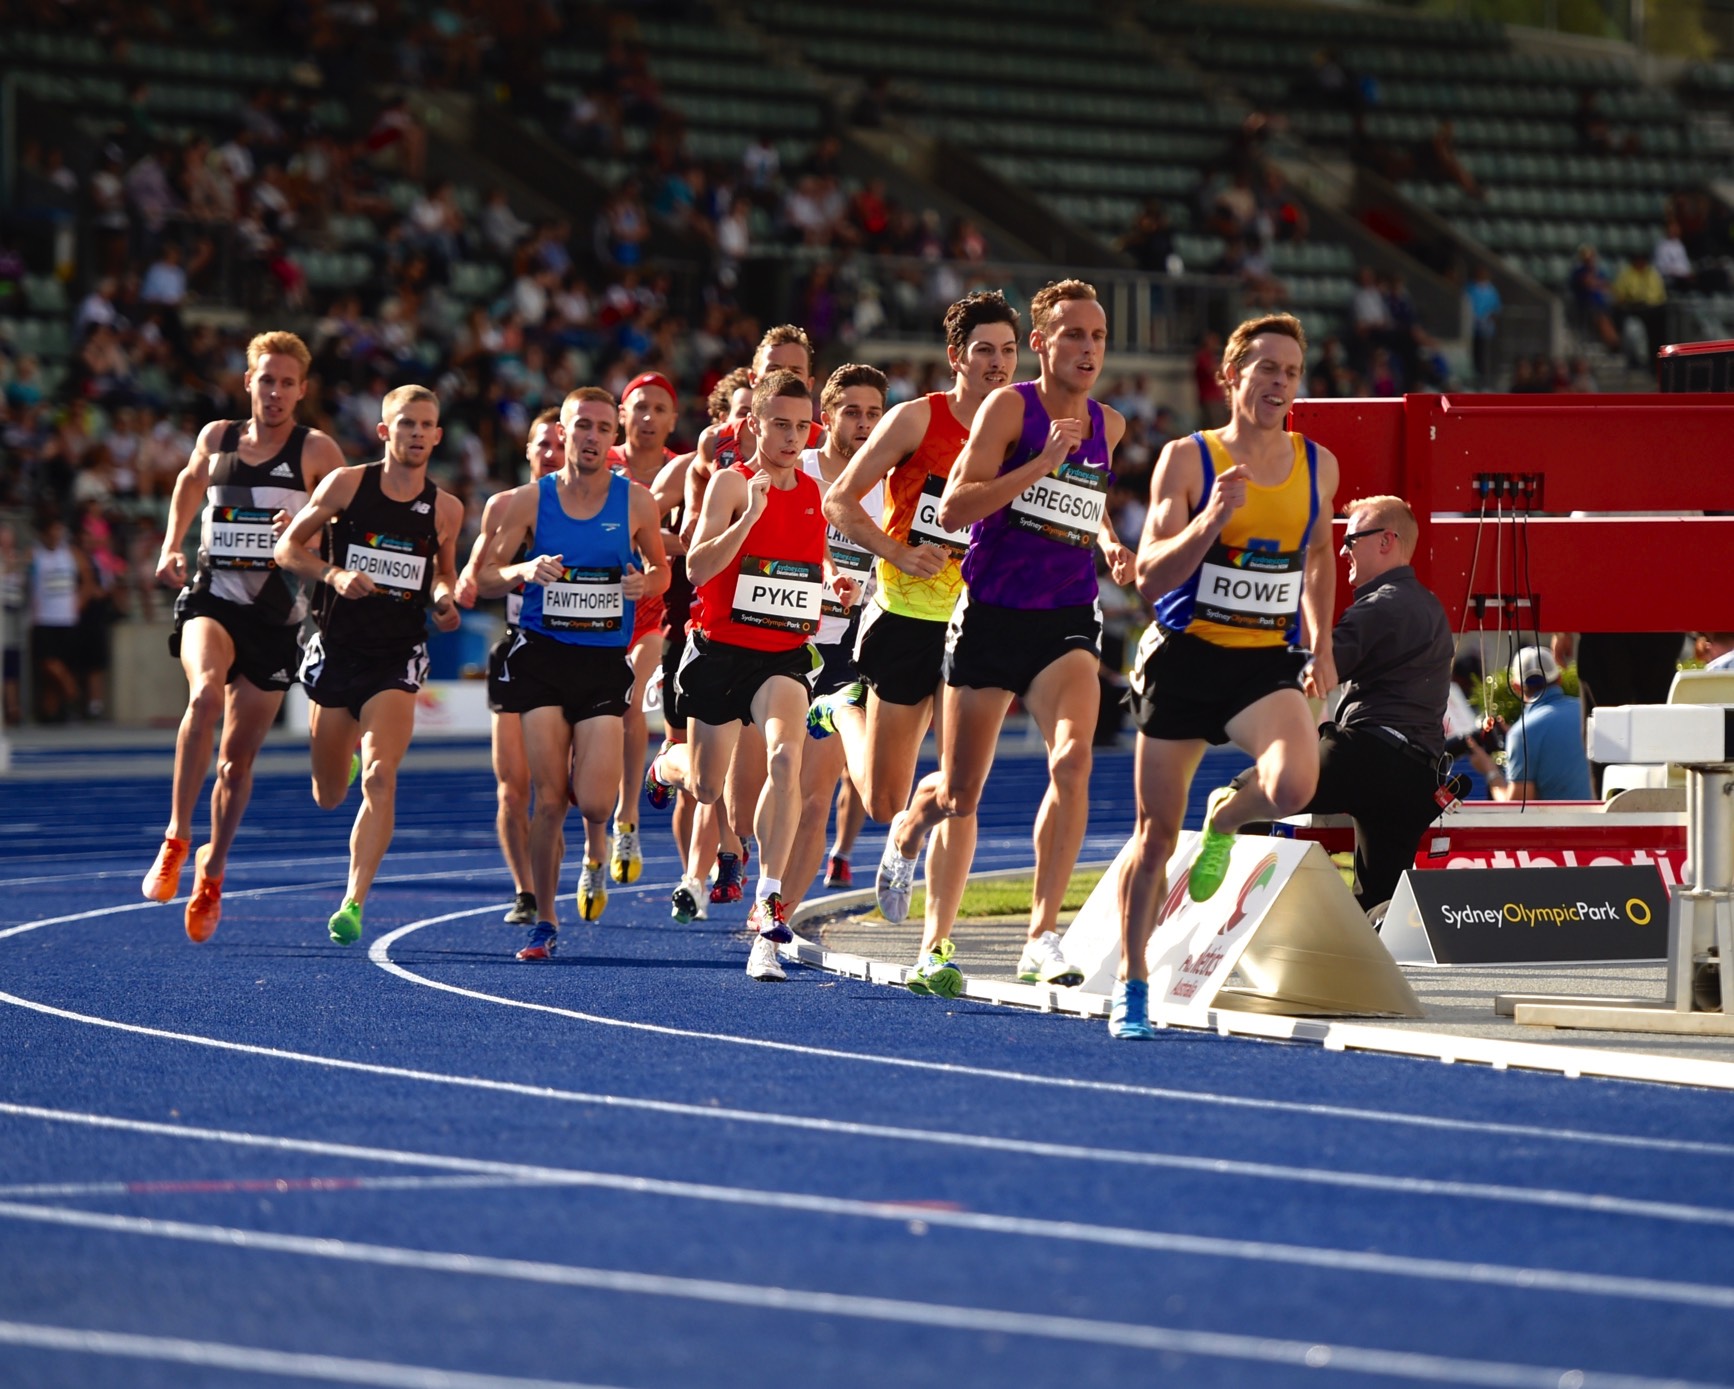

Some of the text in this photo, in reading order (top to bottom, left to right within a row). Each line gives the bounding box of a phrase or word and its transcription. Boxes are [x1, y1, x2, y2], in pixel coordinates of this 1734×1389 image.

[1021, 484, 1101, 522] GREGSON
[349, 553, 421, 580] ROBINSON
[546, 590, 619, 609] FAWTHORPE
[752, 585, 809, 609] PYKE
[1213, 575, 1290, 603] ROWE
[1441, 901, 1620, 929] SydneyOlympicPark
